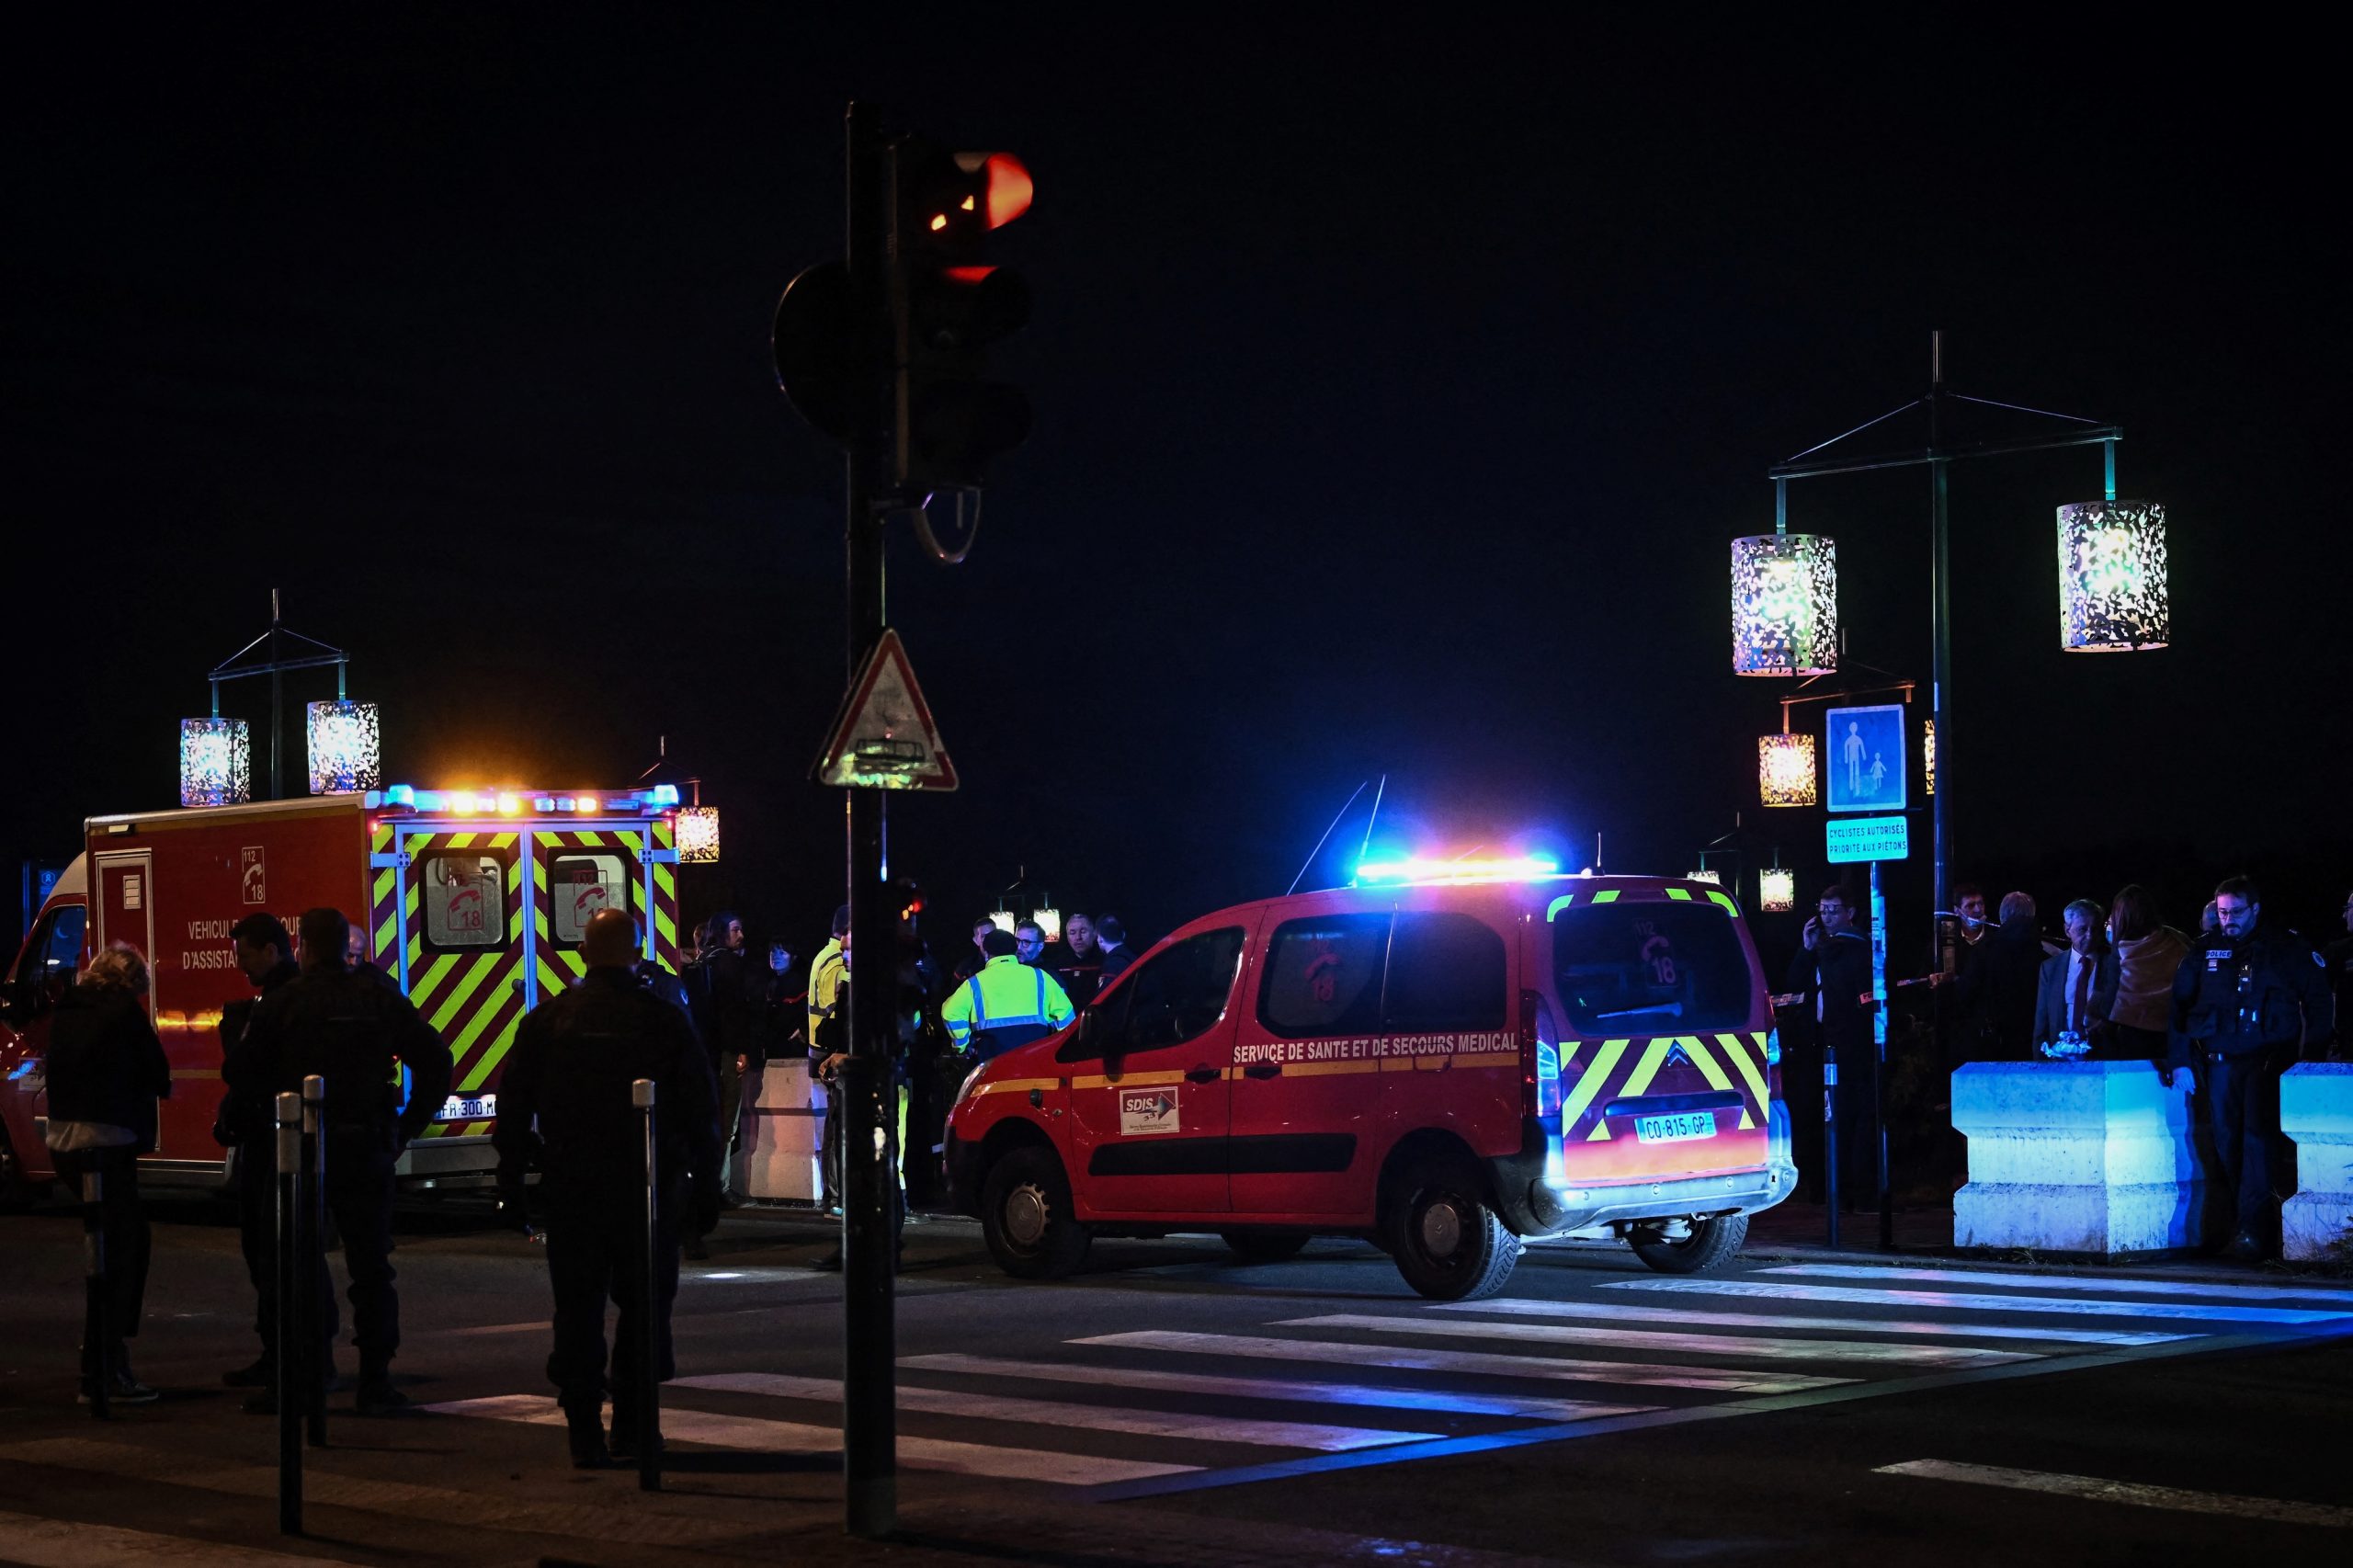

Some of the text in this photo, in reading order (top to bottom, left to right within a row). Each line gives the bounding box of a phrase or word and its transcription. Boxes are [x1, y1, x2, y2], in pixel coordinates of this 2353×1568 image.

[1829, 827, 1865, 838] CYCLISTES
[244, 850, 256, 862] 112
[1862, 843, 1875, 852] AUX
[251, 884, 264, 901] 18
[461, 910, 481, 927] 18
[1633, 920, 1656, 936] 112
[182, 949, 238, 971] D'ASSISTA
[1652, 957, 1677, 983] 18
[1313, 973, 1335, 1001] 18
[1233, 1032, 1518, 1063] SERVICE DE SANTE ET DE SECOURS MEDICAL
[1126, 1097, 1154, 1112] SDIS
